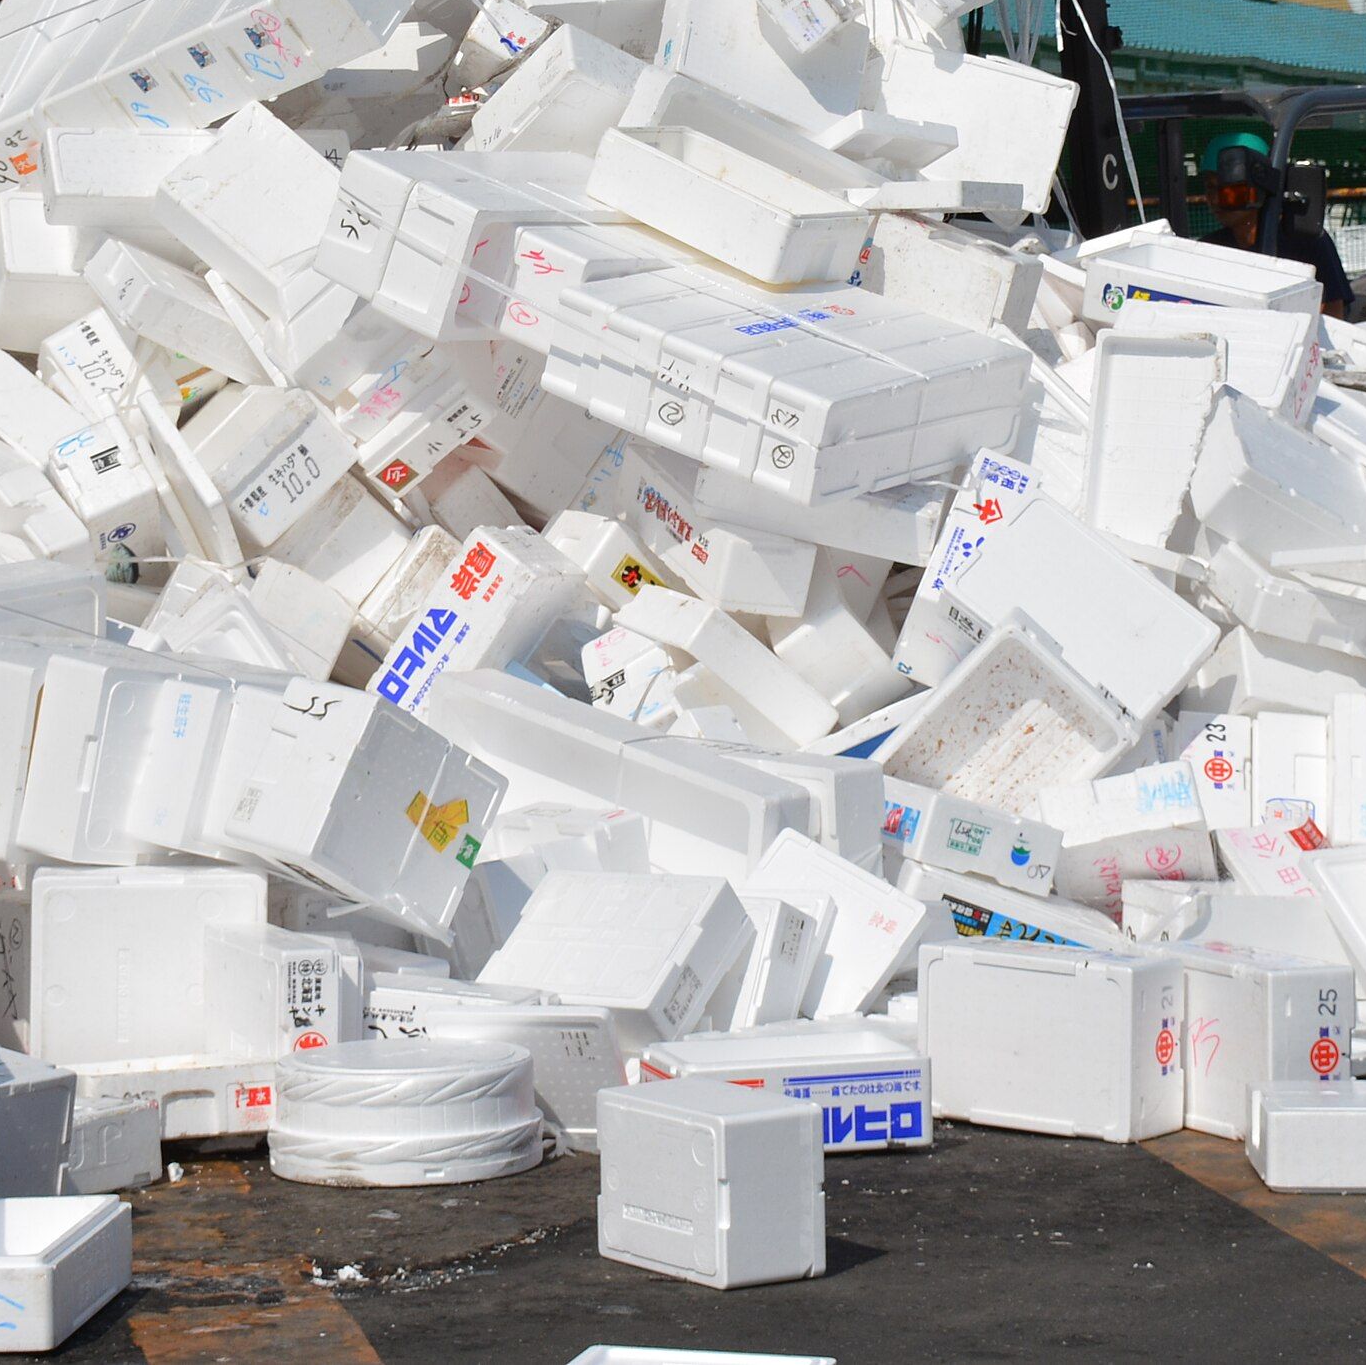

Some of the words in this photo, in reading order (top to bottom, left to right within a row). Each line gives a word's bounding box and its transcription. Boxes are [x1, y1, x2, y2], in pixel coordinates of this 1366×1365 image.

[1101, 153, 1119, 191] C
[282, 456, 321, 505] 10.0
[376, 608, 459, 705] マルヒロ
[1206, 722, 1227, 742] 23
[1317, 987, 1339, 1017] 25
